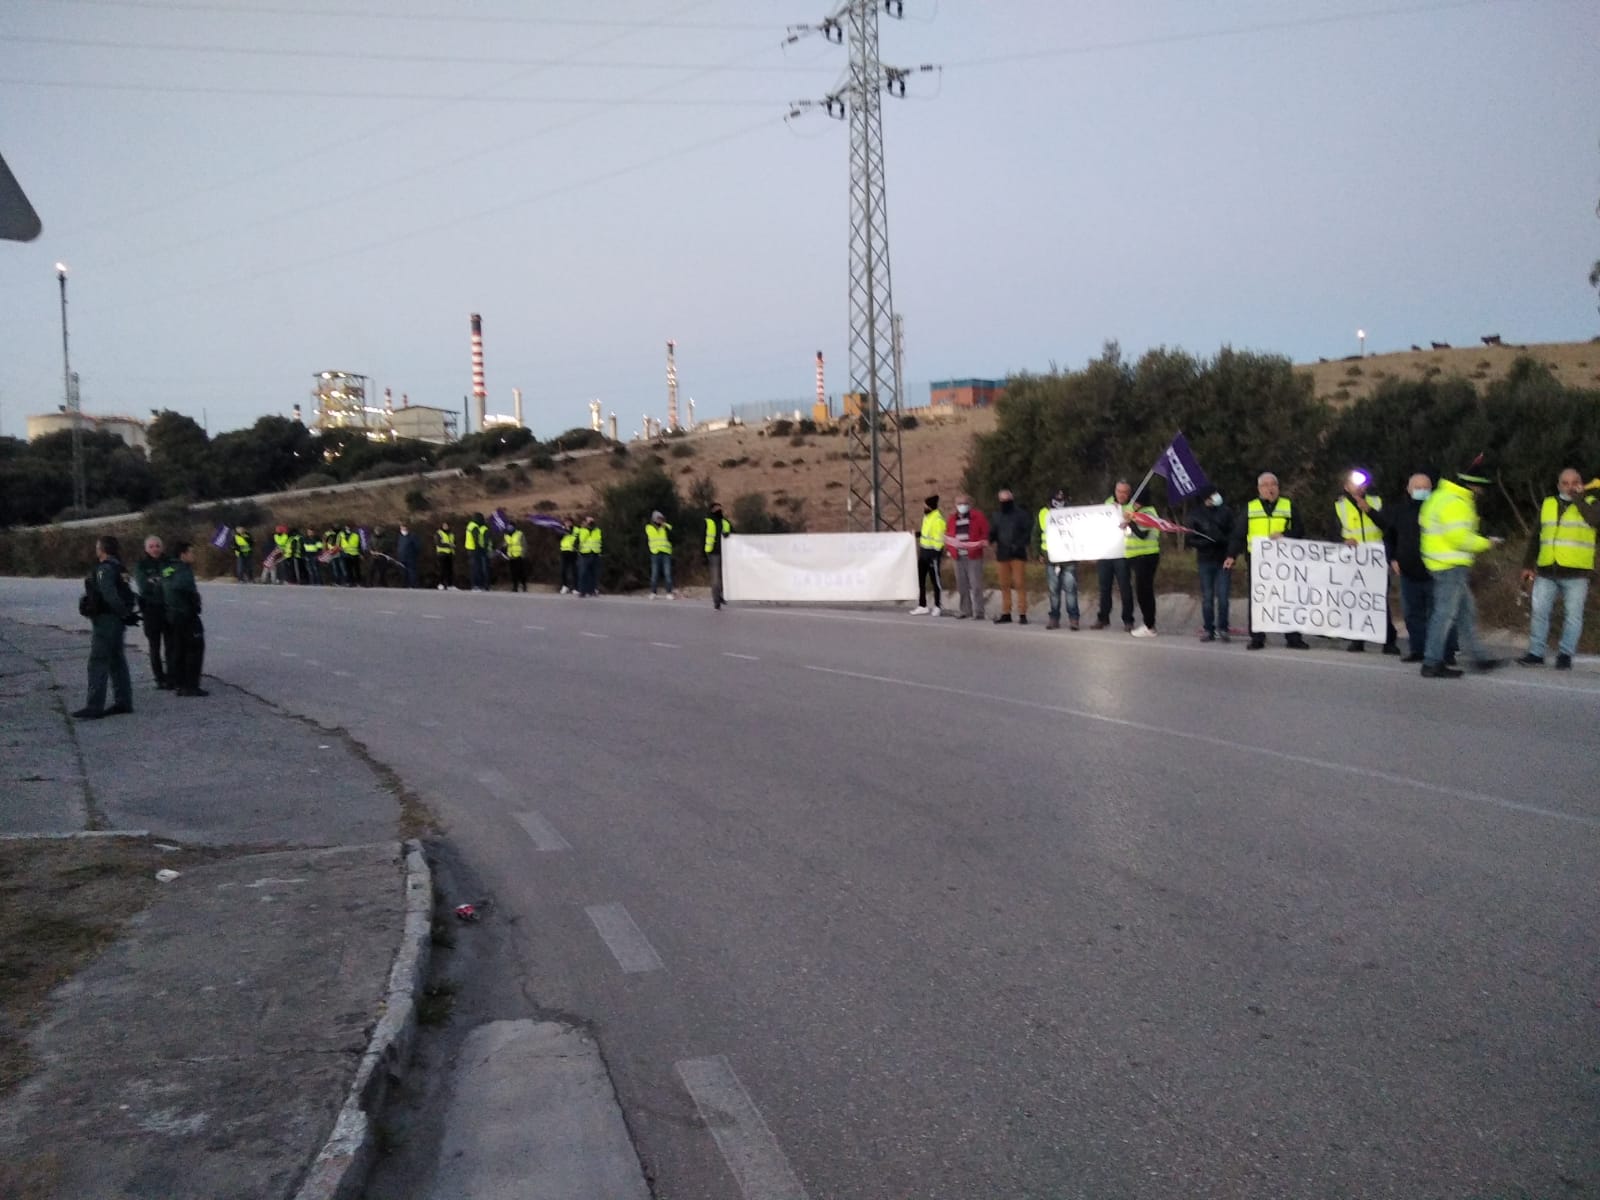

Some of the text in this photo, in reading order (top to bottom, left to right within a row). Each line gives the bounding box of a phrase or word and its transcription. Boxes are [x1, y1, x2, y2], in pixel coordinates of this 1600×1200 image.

[1260, 541, 1384, 568] PROSEGUR
[1258, 562, 1367, 587] CON LA
[1261, 606, 1376, 633] NEGOCIA
